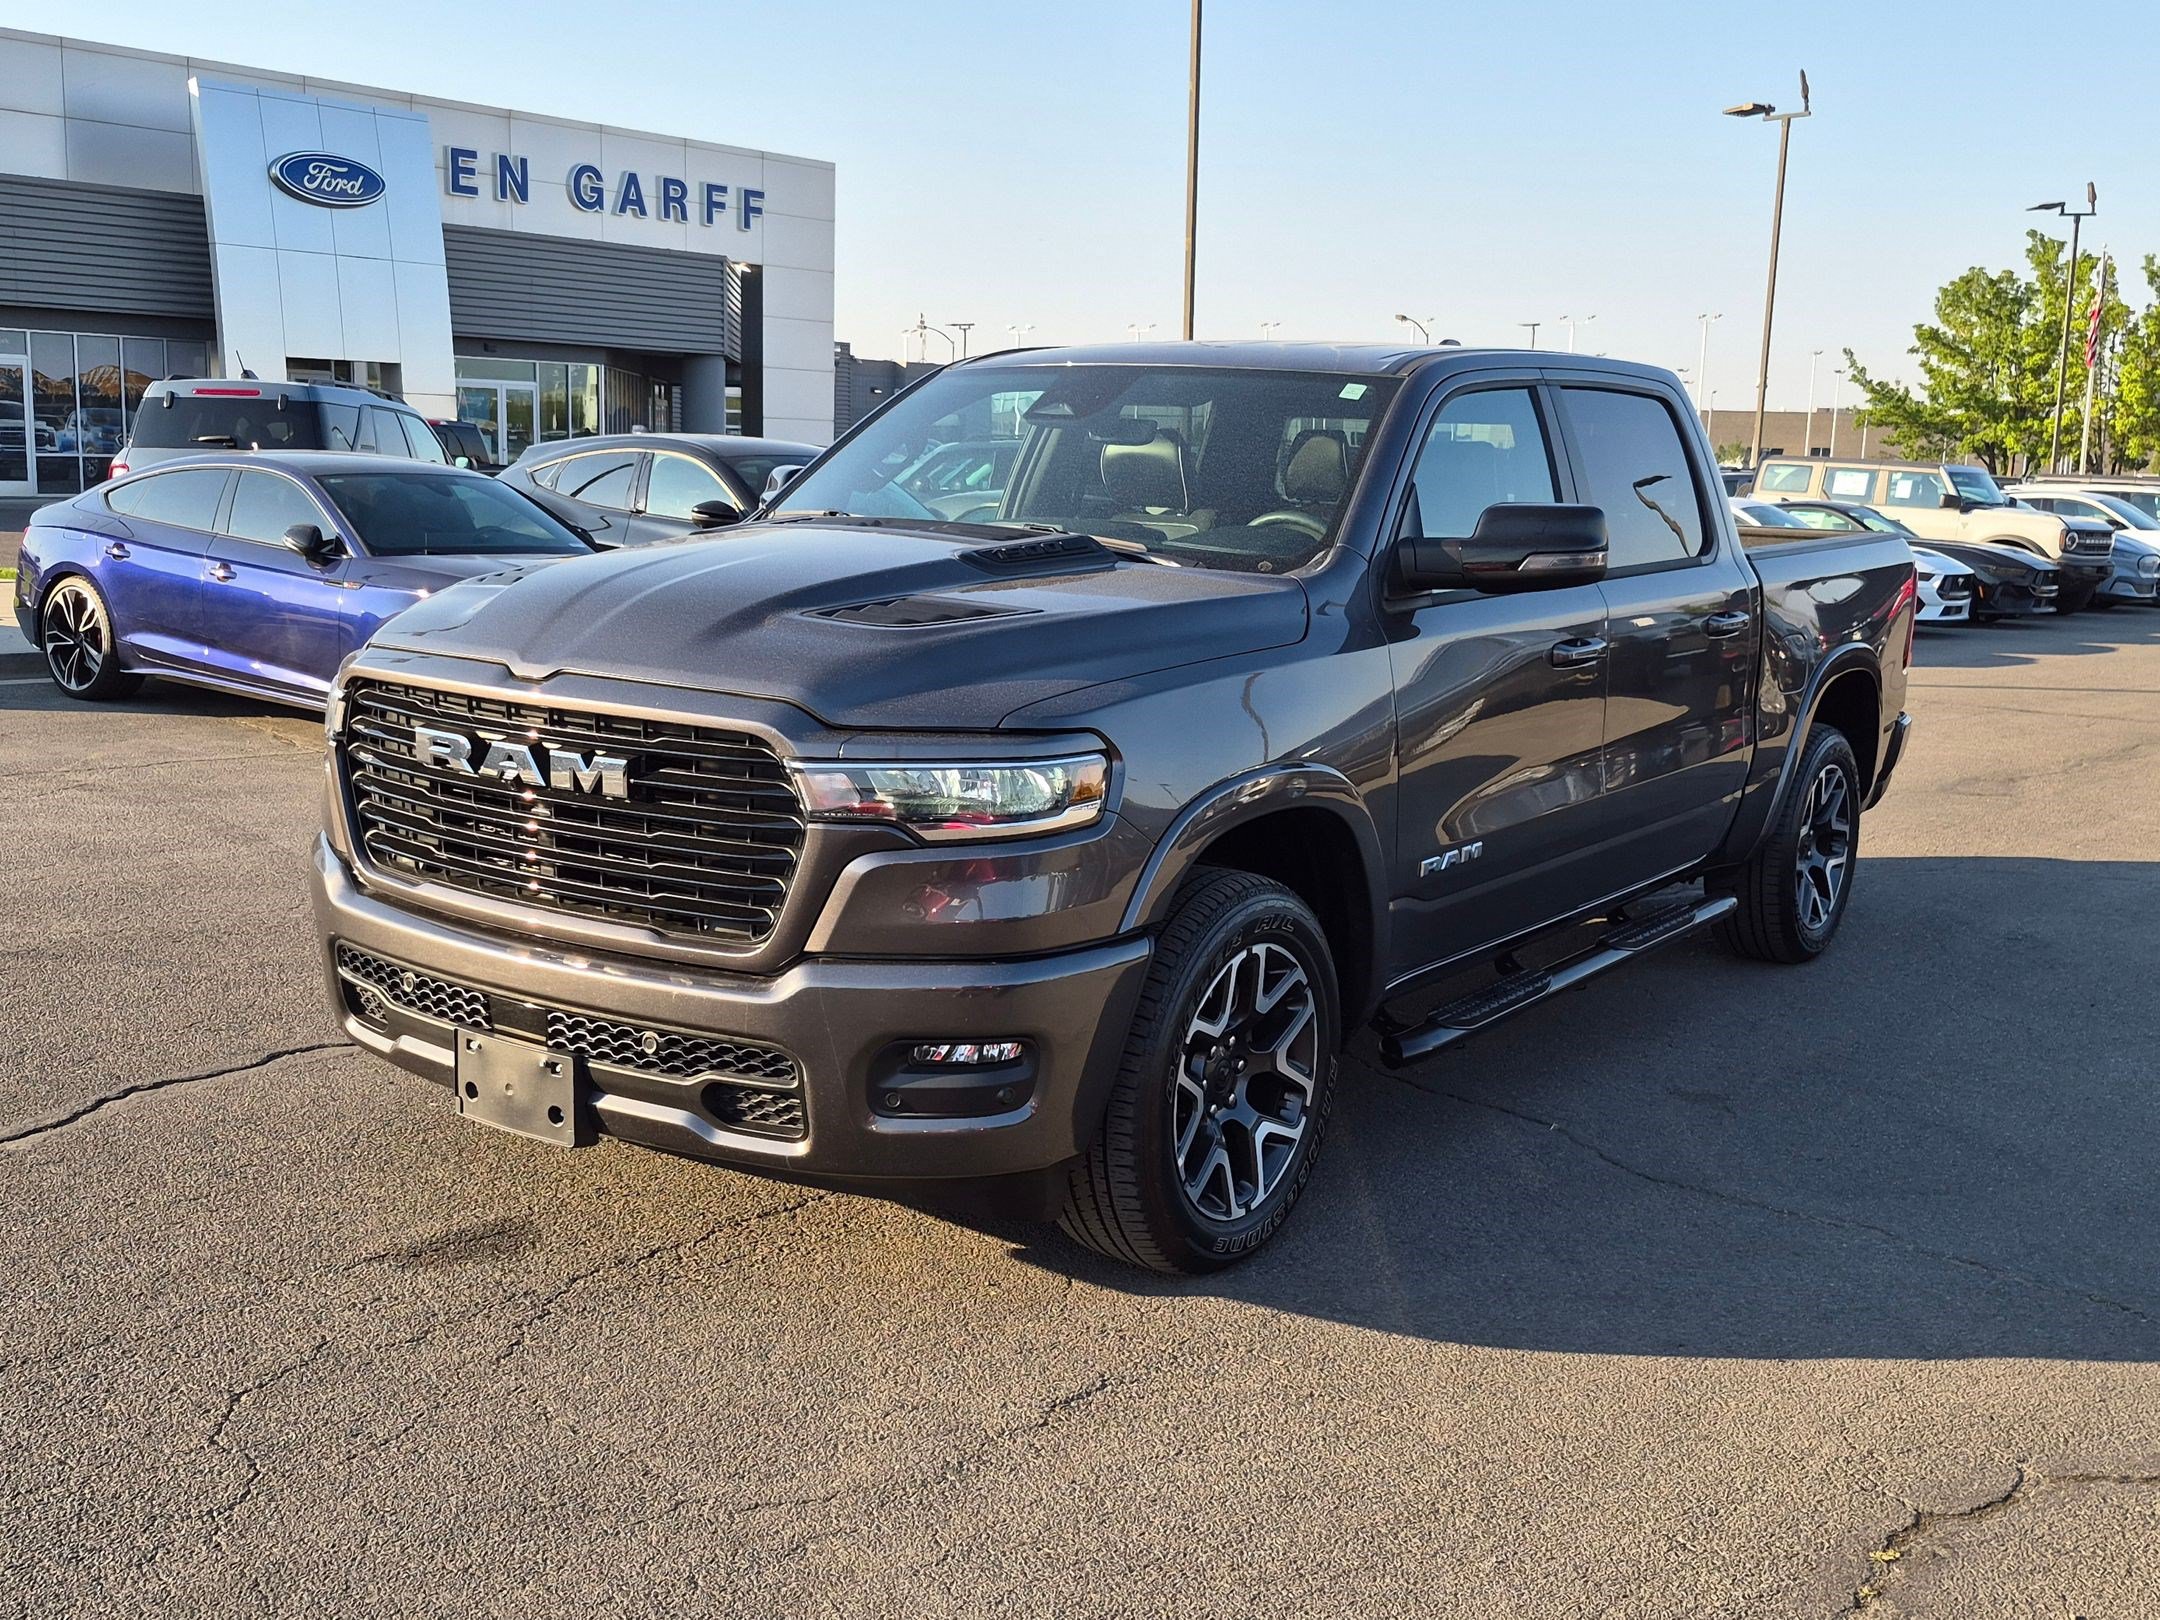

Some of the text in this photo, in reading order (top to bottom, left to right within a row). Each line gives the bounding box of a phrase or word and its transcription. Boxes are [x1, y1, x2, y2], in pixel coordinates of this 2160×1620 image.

[303, 161, 364, 196] Ford
[446, 146, 765, 231] EN GARFF
[415, 726, 629, 798] RAM
[1418, 841, 1483, 878] RAM
